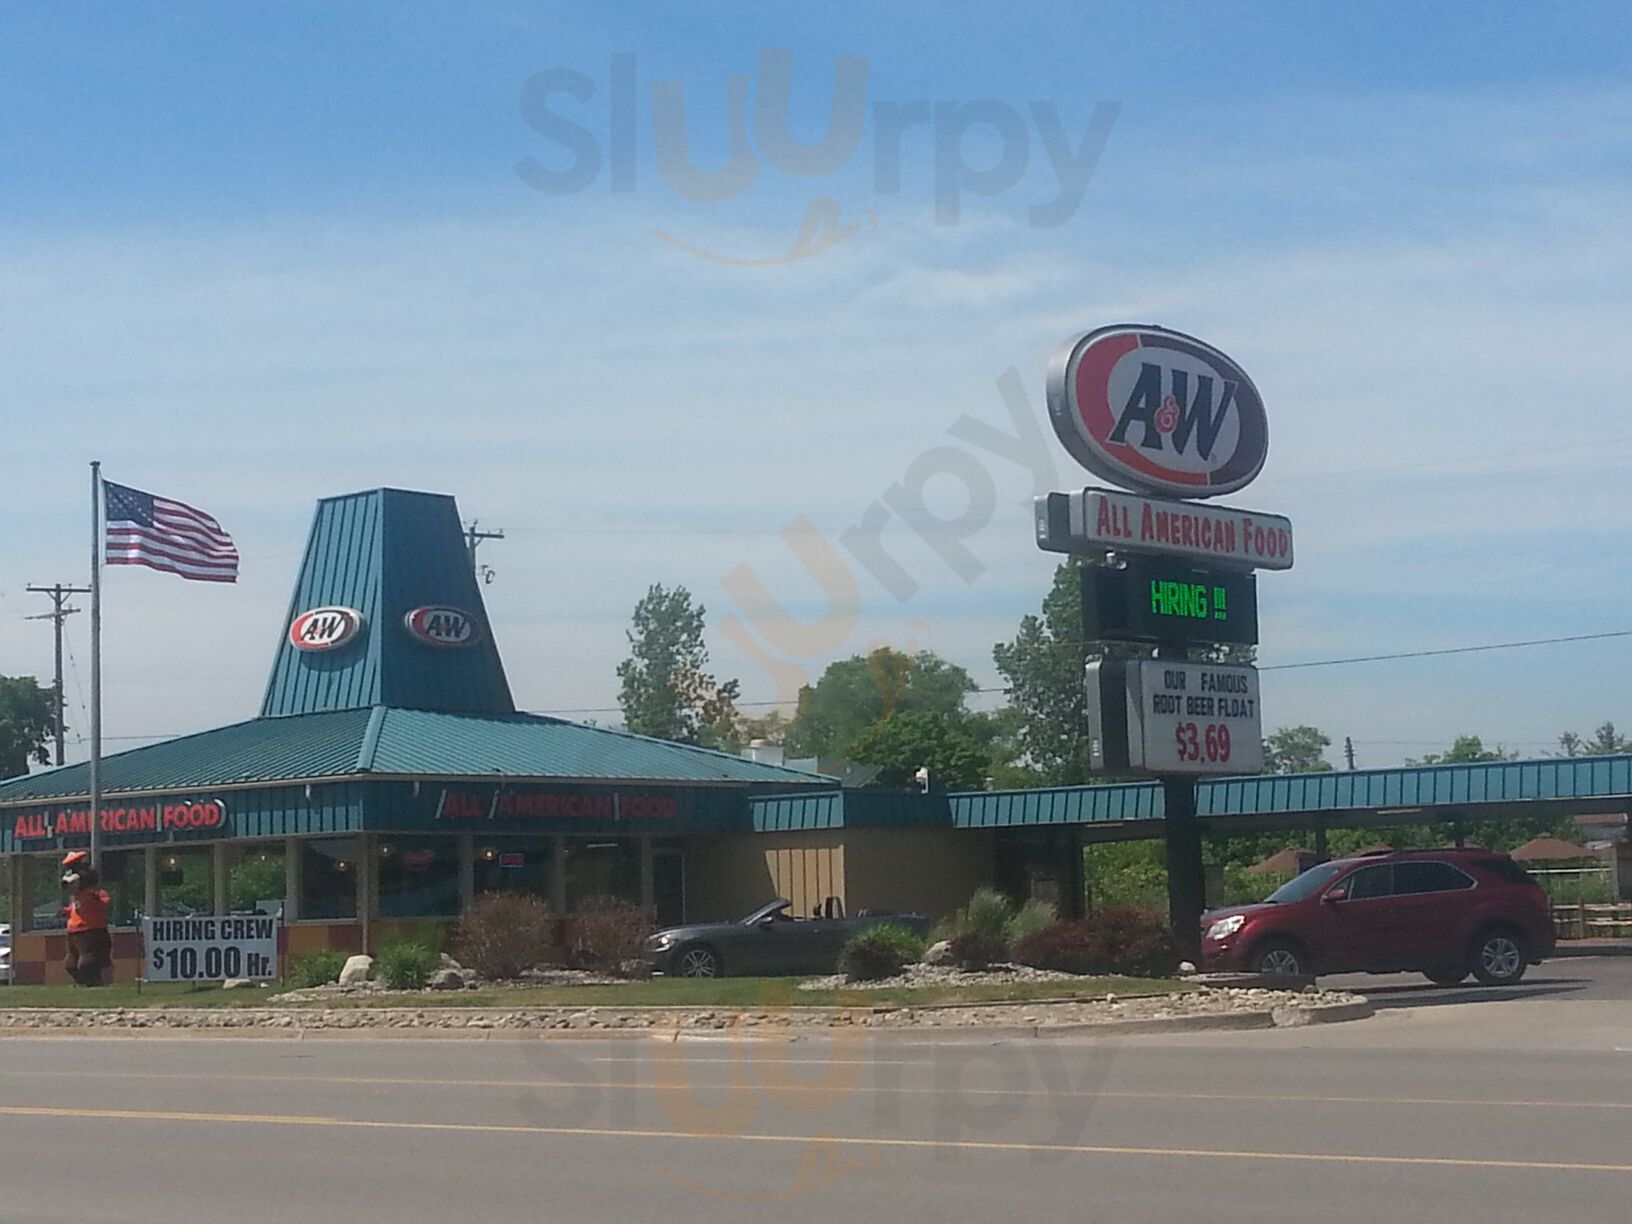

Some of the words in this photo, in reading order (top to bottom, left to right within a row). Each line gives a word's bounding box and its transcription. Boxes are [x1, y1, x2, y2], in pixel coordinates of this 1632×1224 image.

[1105, 362, 1238, 461] A&W
[1097, 496, 1132, 537] ALL
[1241, 518, 1288, 558] FOOD
[1152, 580, 1207, 618] HIRING
[1164, 670, 1186, 691] OUR
[1201, 673, 1248, 694] FAMOUS
[1153, 695, 1181, 714] ROOT
[1187, 696, 1214, 716] BEER
[1218, 697, 1254, 718] FLOAT
[1175, 721, 1231, 763] $3.69
[13, 815, 46, 837] ALL
[163, 803, 220, 827] FOOD
[443, 793, 481, 817] ALL
[152, 920, 215, 941] HIRING
[220, 919, 274, 941] CREW
[153, 946, 241, 979] $10.00
[247, 953, 273, 976] Hr.
